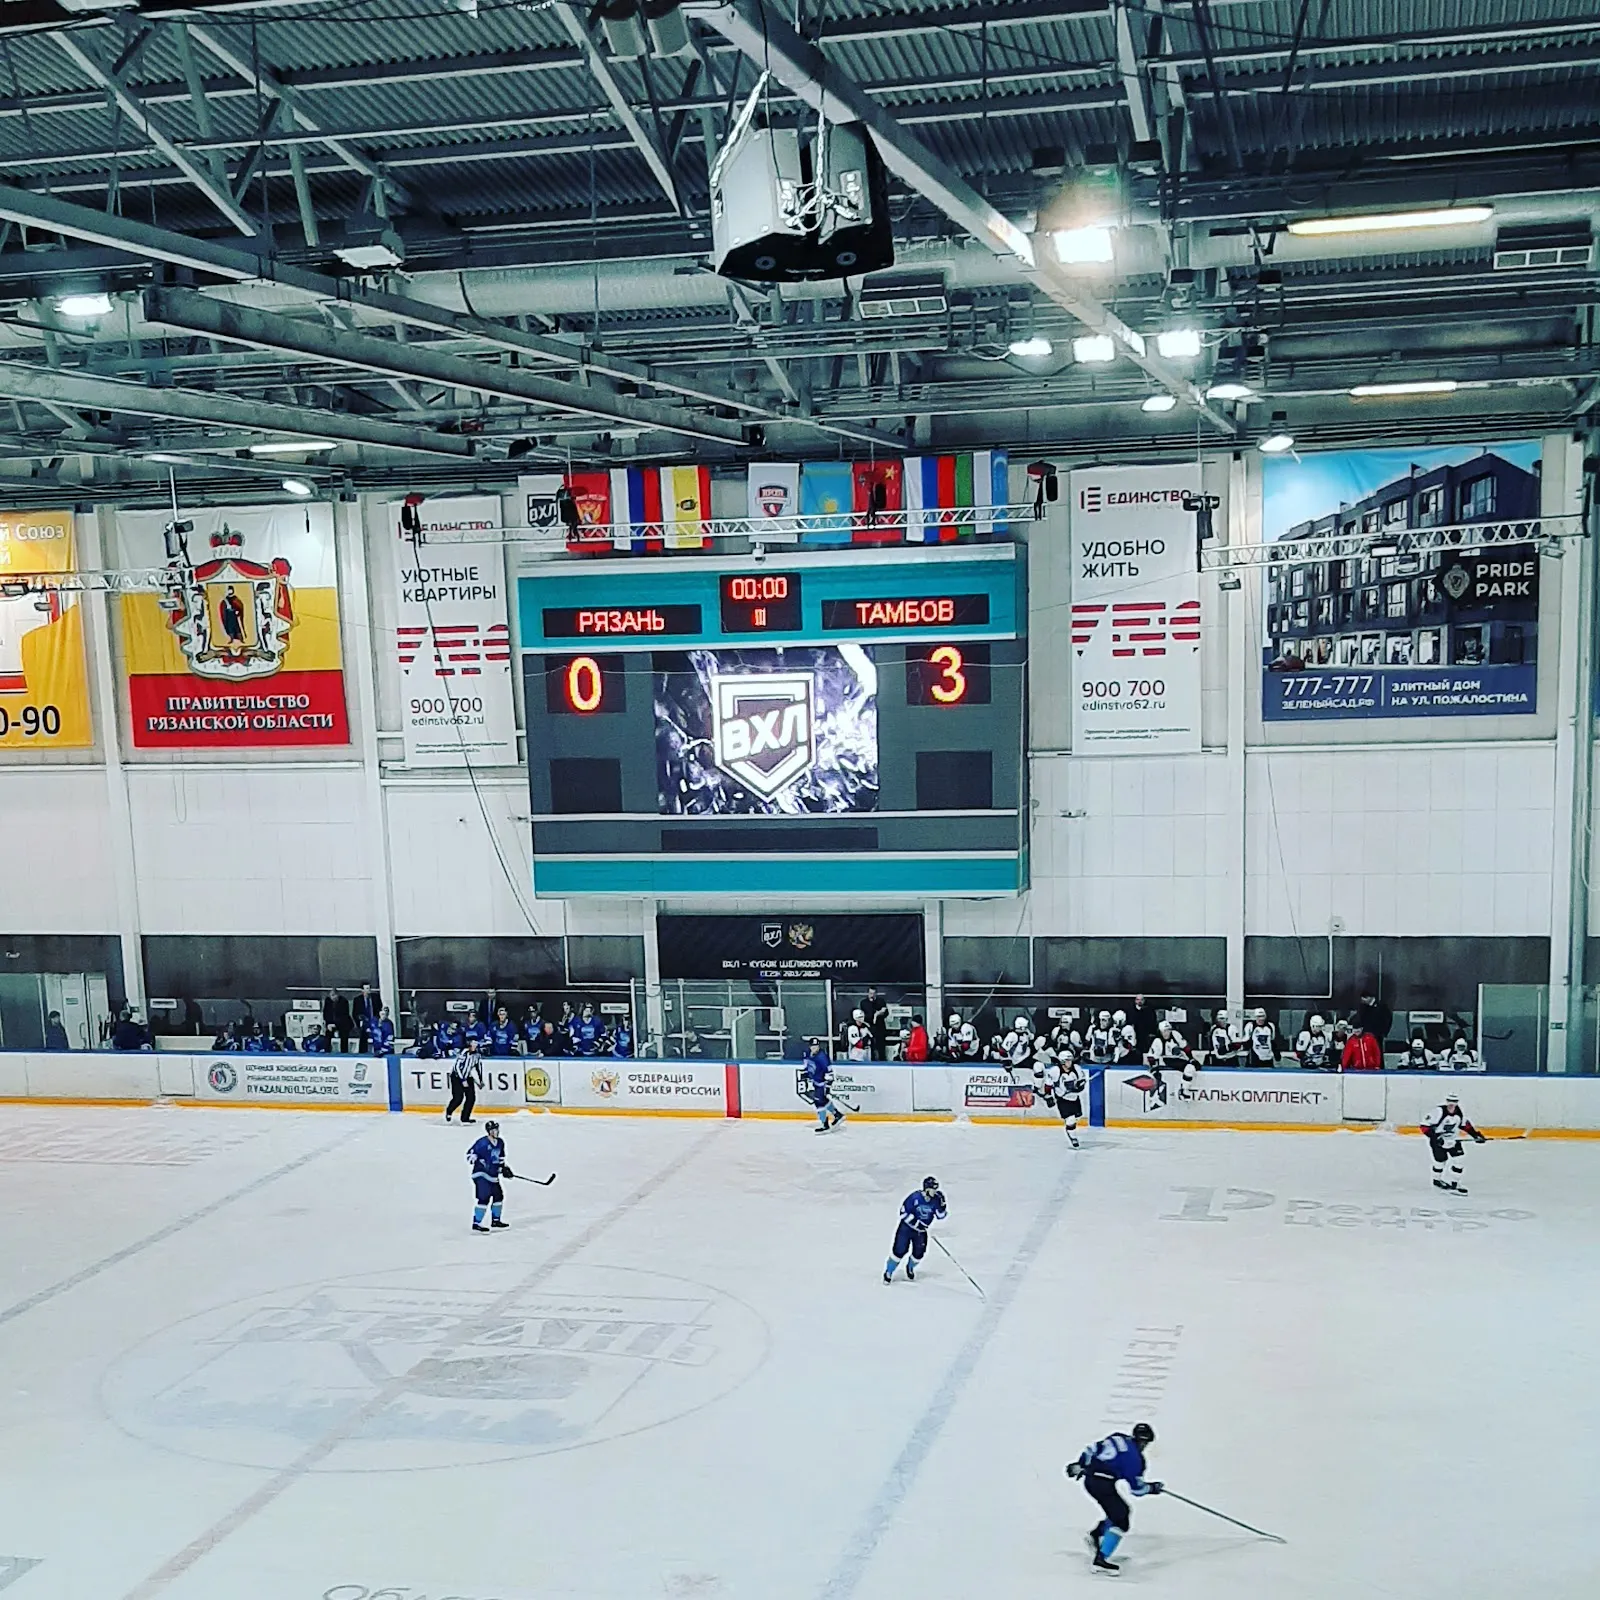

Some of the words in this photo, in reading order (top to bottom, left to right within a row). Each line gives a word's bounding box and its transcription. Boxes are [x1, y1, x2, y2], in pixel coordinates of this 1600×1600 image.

[1107, 490, 1192, 505] ЕДИНСТВО
[15, 522, 66, 541] Союз
[1081, 539, 1165, 558] УДОБНО
[401, 566, 479, 584] УЮТНЫЕ
[1081, 562, 1139, 579] ЖИТЬ
[1476, 562, 1535, 578] PRIDE
[403, 585, 497, 603] КВАРТИРЫ
[732, 577, 788, 600] 00:00
[1476, 582, 1530, 598] PARK
[579, 610, 665, 633] РЯЗАНЬ
[856, 600, 955, 625] ТАМБОВ
[567, 656, 602, 711] 0
[930, 647, 966, 703] 3
[1082, 681, 1121, 698] 900
[1127, 679, 1165, 696] 700
[1281, 676, 1373, 696] 777-777
[1391, 679, 1450, 692] ЭЛИТНЫЙ
[1452, 680, 1481, 691] ДОМ
[168, 694, 310, 712] ПРАВИТЕЛЬСТВО
[411, 698, 445, 714] 900
[449, 697, 483, 712] 700
[1082, 699, 1166, 711] edinstvo62.ru
[1391, 697, 1408, 706] НА
[1433, 694, 1528, 704] ПОЖАЛОСТИНА
[148, 712, 249, 730] РЯЗАНСКОЙ
[253, 712, 334, 729] ОБЛАСТИ
[721, 703, 808, 761] ВХЛ
[411, 1071, 518, 1091] TEISI
[628, 1074, 694, 1084] ФЕДЕРАЦИЯ
[628, 1085, 672, 1095] ХОККЕЯ
[675, 1086, 721, 1096] РОССИИ
